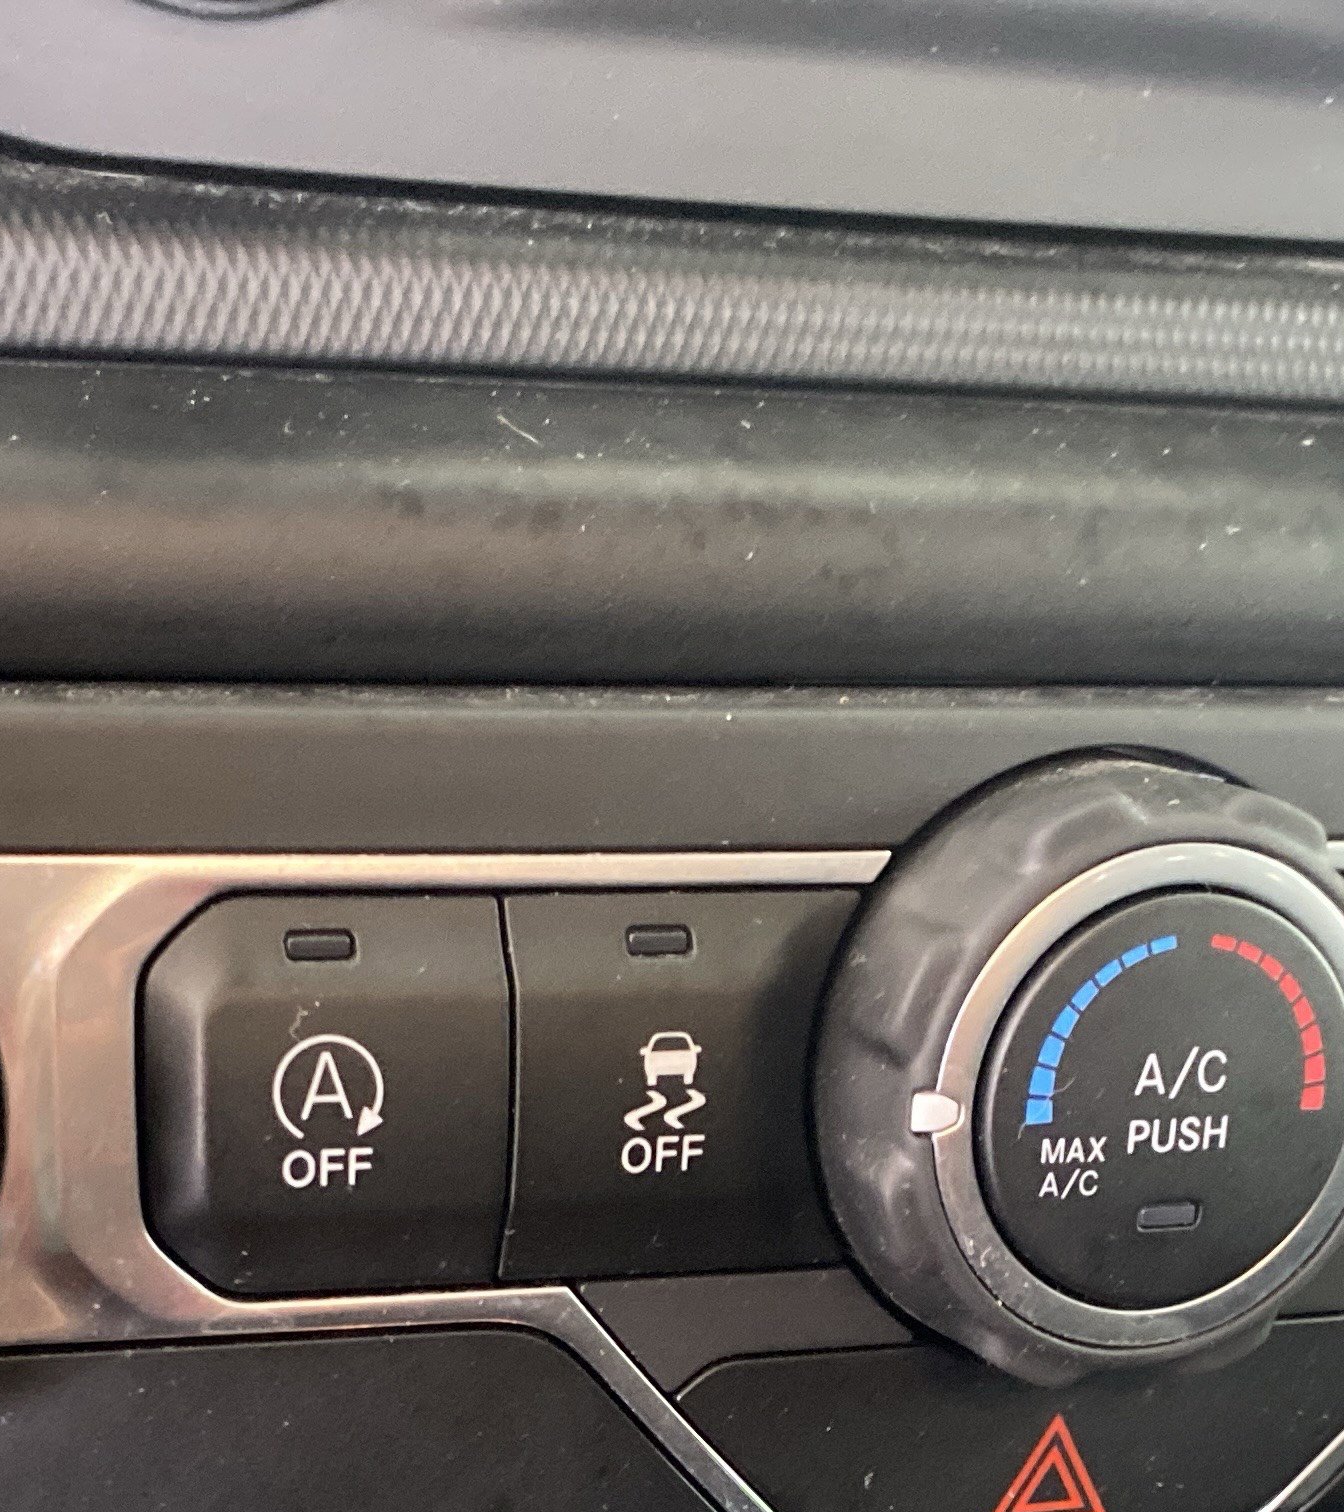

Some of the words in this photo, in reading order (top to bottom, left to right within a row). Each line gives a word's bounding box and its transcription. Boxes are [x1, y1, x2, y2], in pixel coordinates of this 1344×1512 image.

[1134, 1046, 1229, 1100] A/C
[621, 1133, 707, 1174] OFF
[1040, 1136, 1108, 1165] MAX
[1126, 1113, 1230, 1156] PUSH
[281, 1146, 375, 1189] OFF
[1038, 1167, 1100, 1200] A/C
